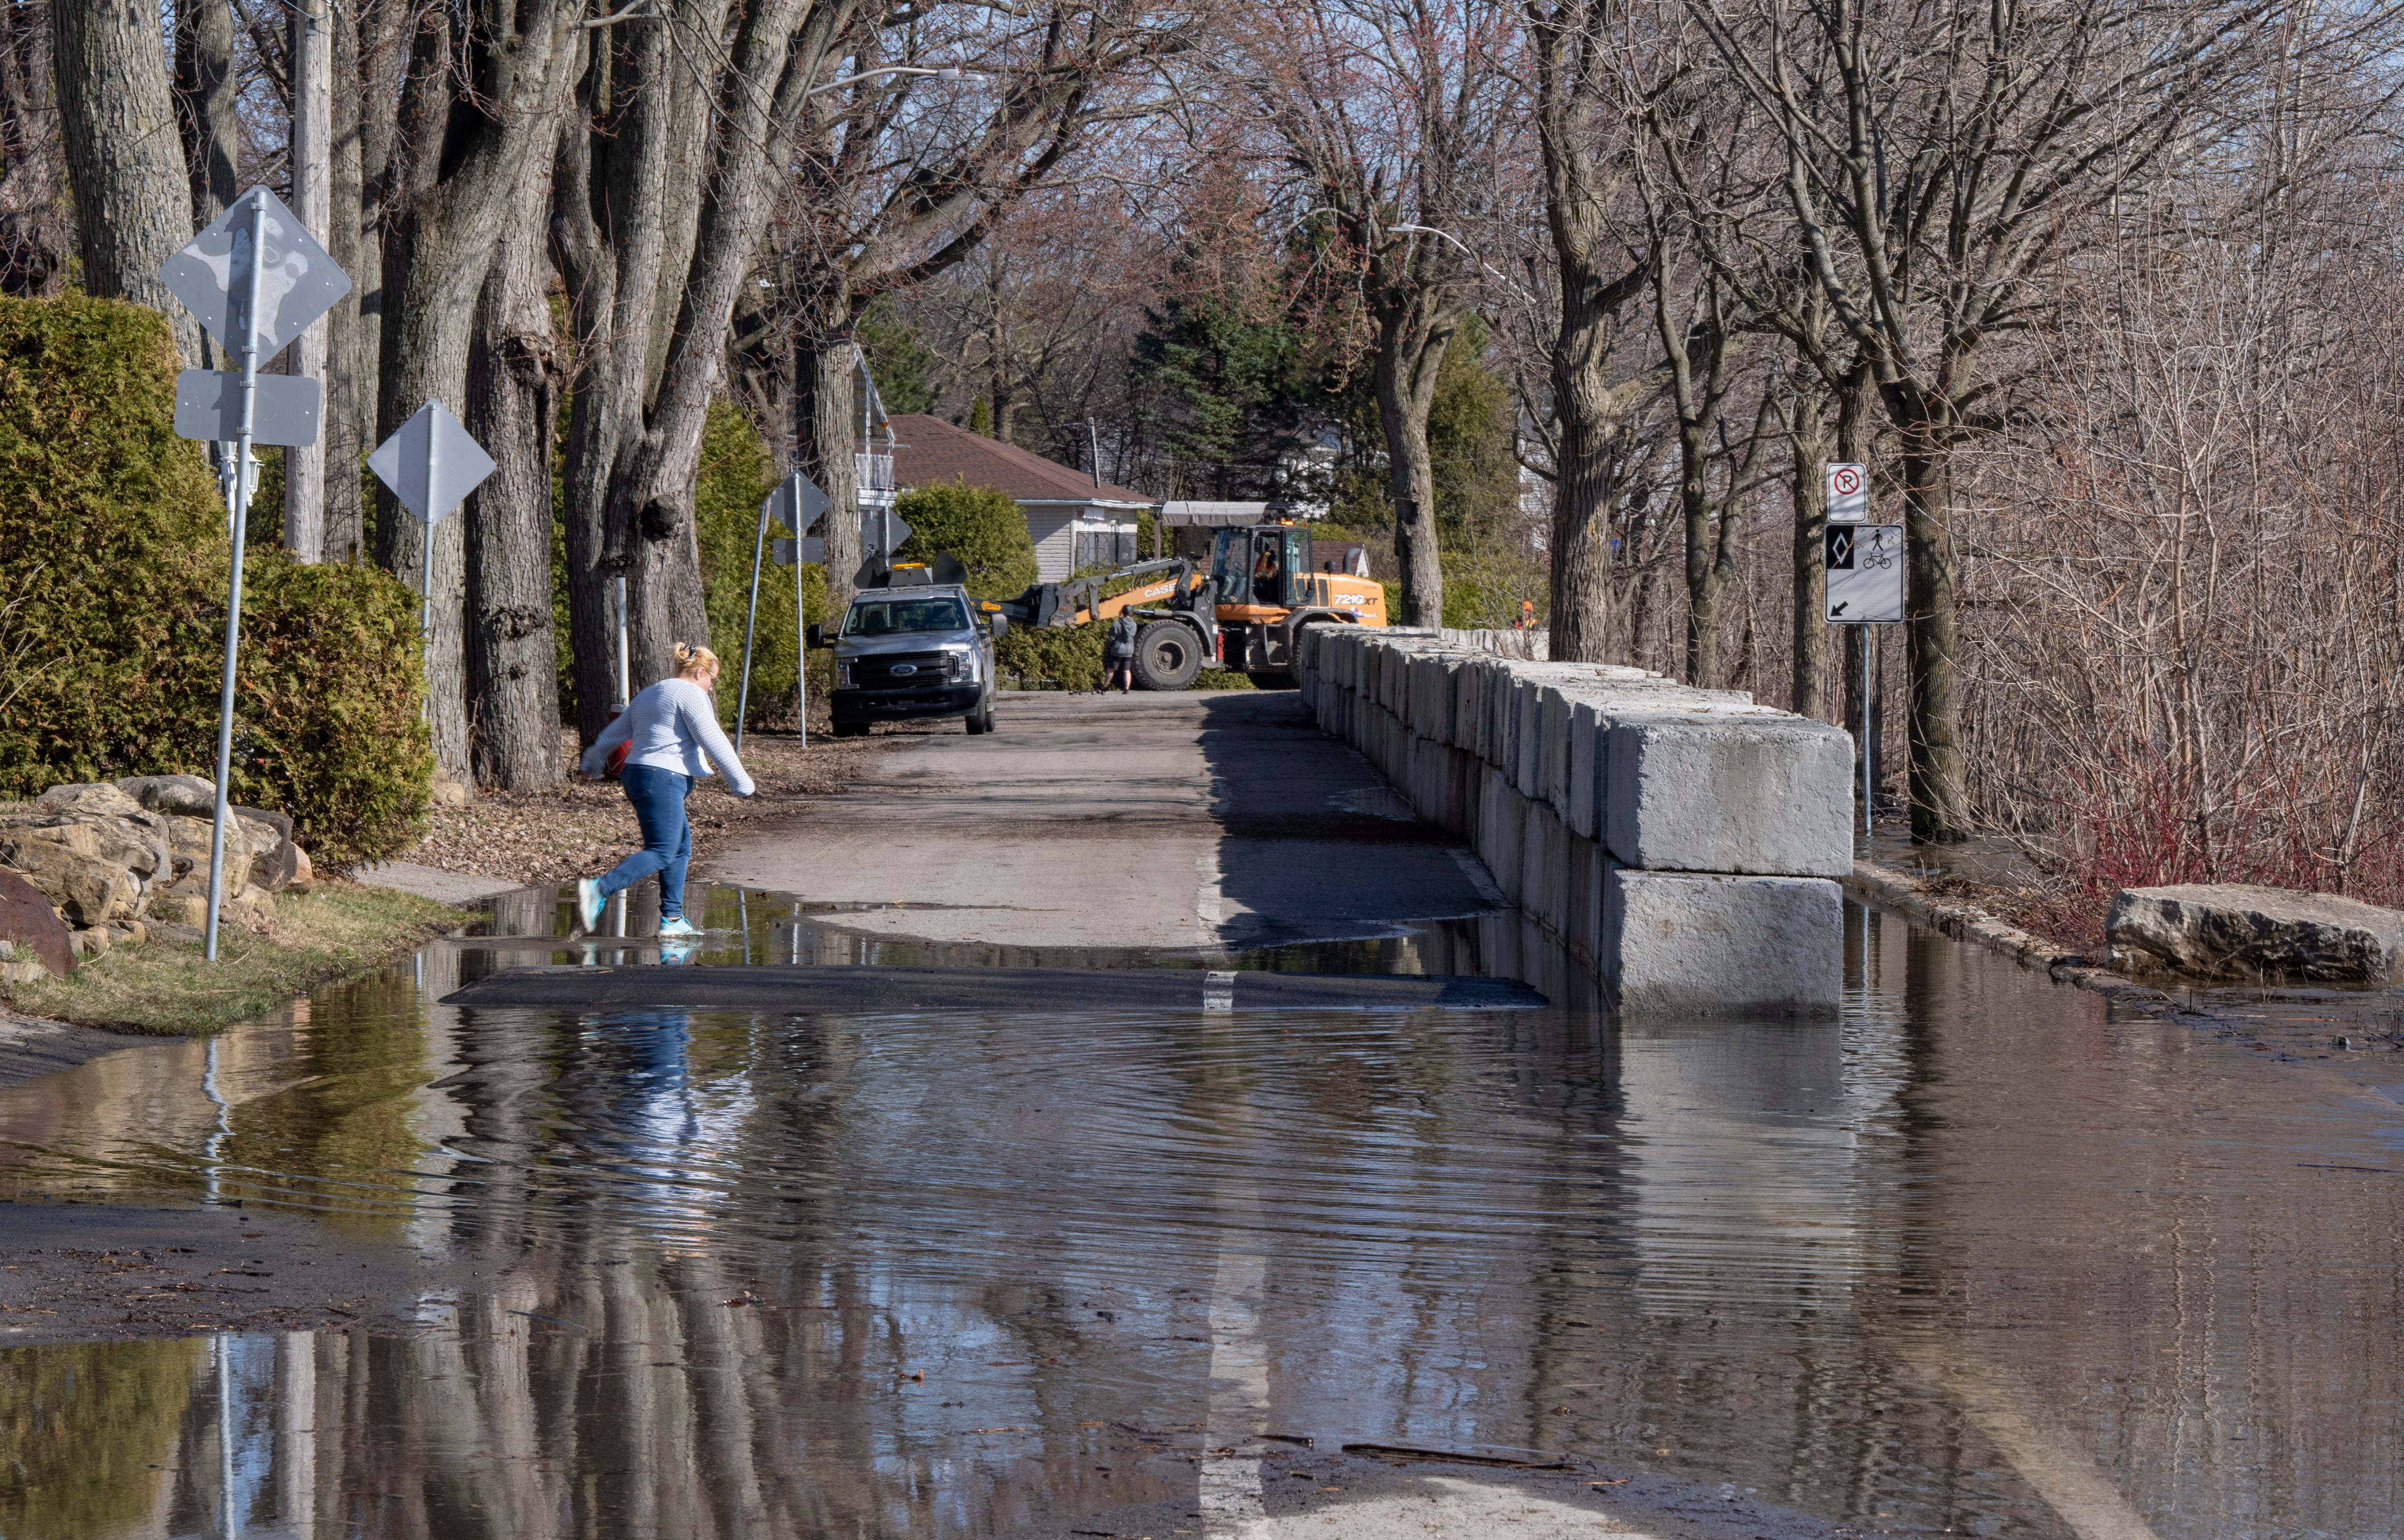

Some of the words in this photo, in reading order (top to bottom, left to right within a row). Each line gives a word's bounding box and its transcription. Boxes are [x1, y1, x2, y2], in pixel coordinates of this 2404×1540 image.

[1843, 475, 1852, 488] P
[1144, 582, 1177, 598] CASE
[1334, 594, 1364, 604] 721G
